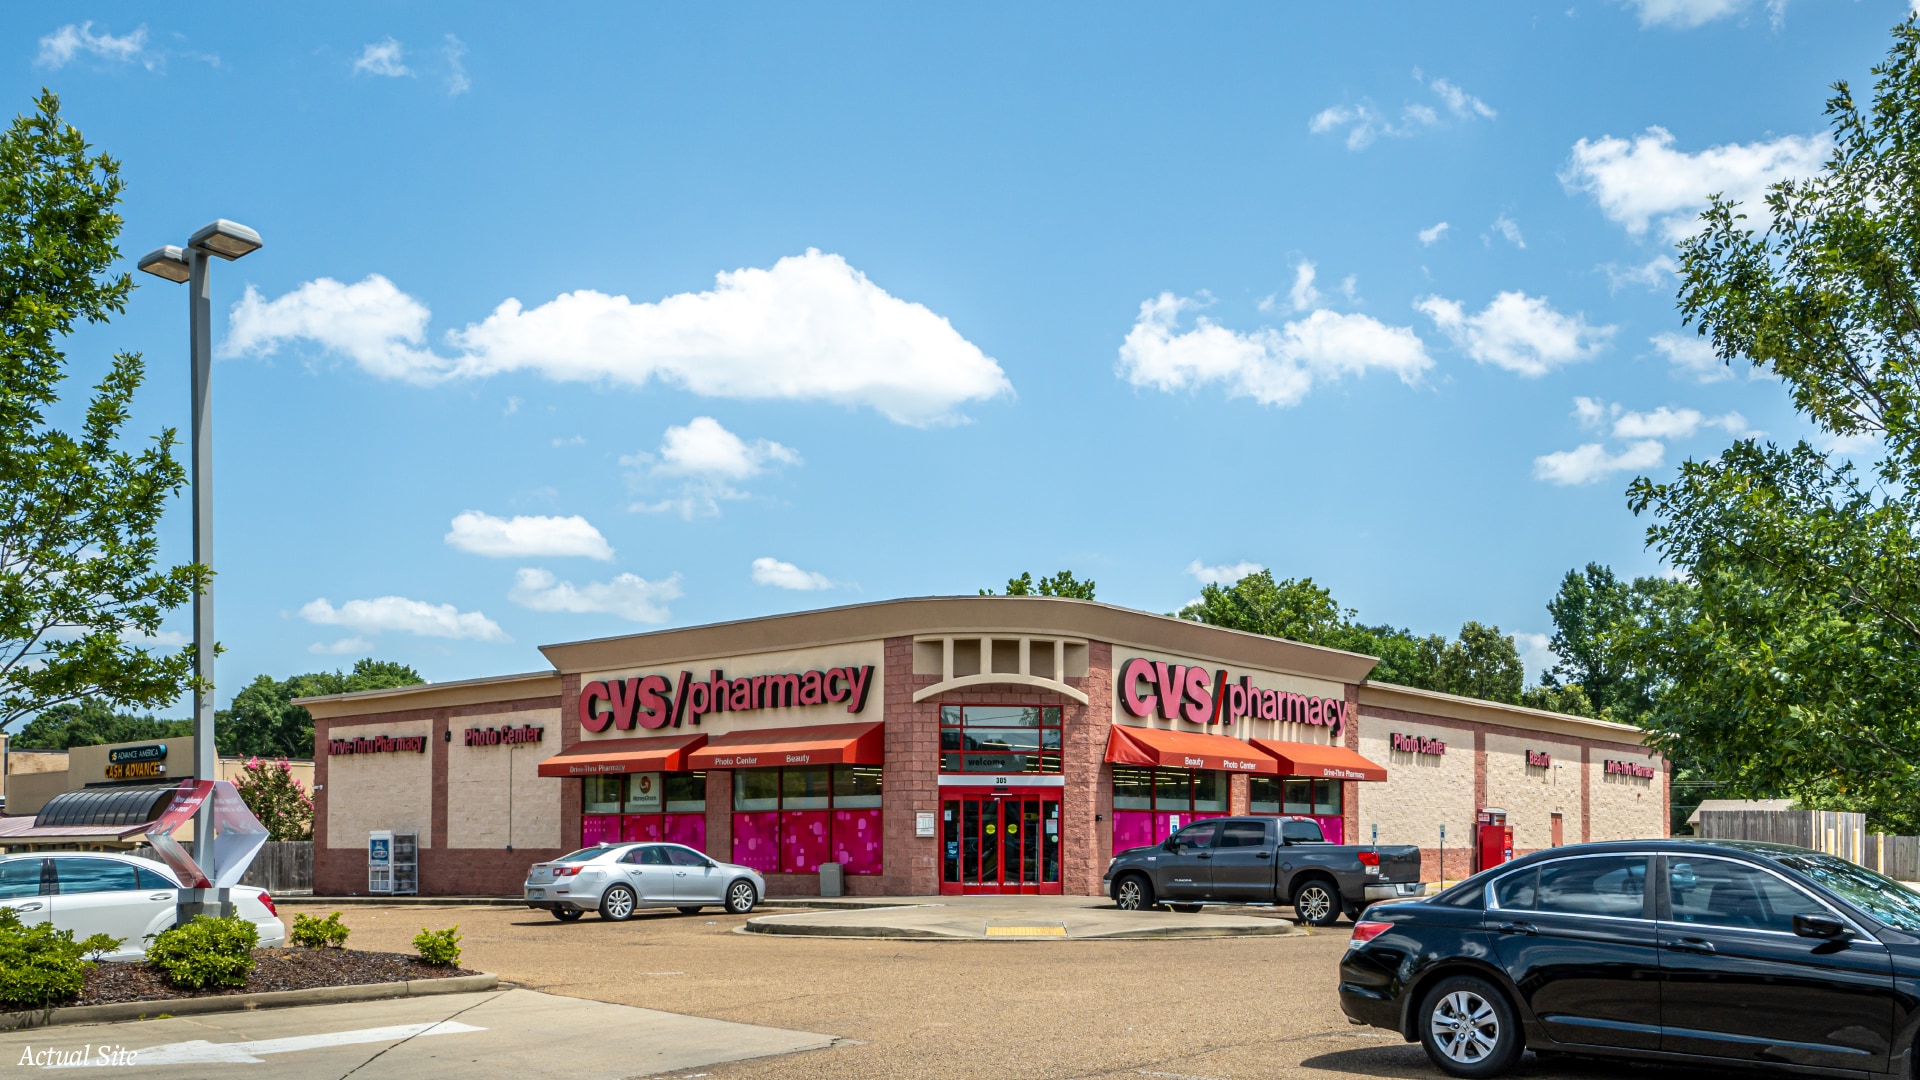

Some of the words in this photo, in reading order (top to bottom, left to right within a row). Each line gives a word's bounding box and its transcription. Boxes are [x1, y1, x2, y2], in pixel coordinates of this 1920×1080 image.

[578, 665, 874, 733] CVS/pharmacy
[1118, 657, 1348, 737] CVS/pharmacy
[465, 728, 497, 746] Photo
[500, 724, 544, 744] Center
[328, 737, 374, 755] Drive-Thru
[374, 735, 427, 753] Pharmacy
[1390, 733, 1419, 753] Photo
[1420, 735, 1447, 755] Center
[118, 750, 138, 760] ADVANCE
[139, 749, 159, 758] AMERICA
[714, 757, 734, 766] Photo
[736, 756, 757, 765] Center
[786, 754, 810, 764] Beauty
[1185, 756, 1204, 768] Beauty
[1526, 750, 1551, 769] Beauty
[104, 764, 123, 779] CASH
[125, 761, 159, 777] ADVANCE
[569, 765, 597, 773] Drive-Thru
[598, 764, 625, 773] Pharmacy
[968, 758, 1006, 767] welcome
[1223, 759, 1238, 769] Photo
[1239, 761, 1256, 770] Center
[1604, 760, 1632, 776] Drive-Thru
[1631, 762, 1655, 779] Pharmacy
[1323, 768, 1345, 777] Drive-Thru
[1345, 769, 1365, 779] Pharmacy
